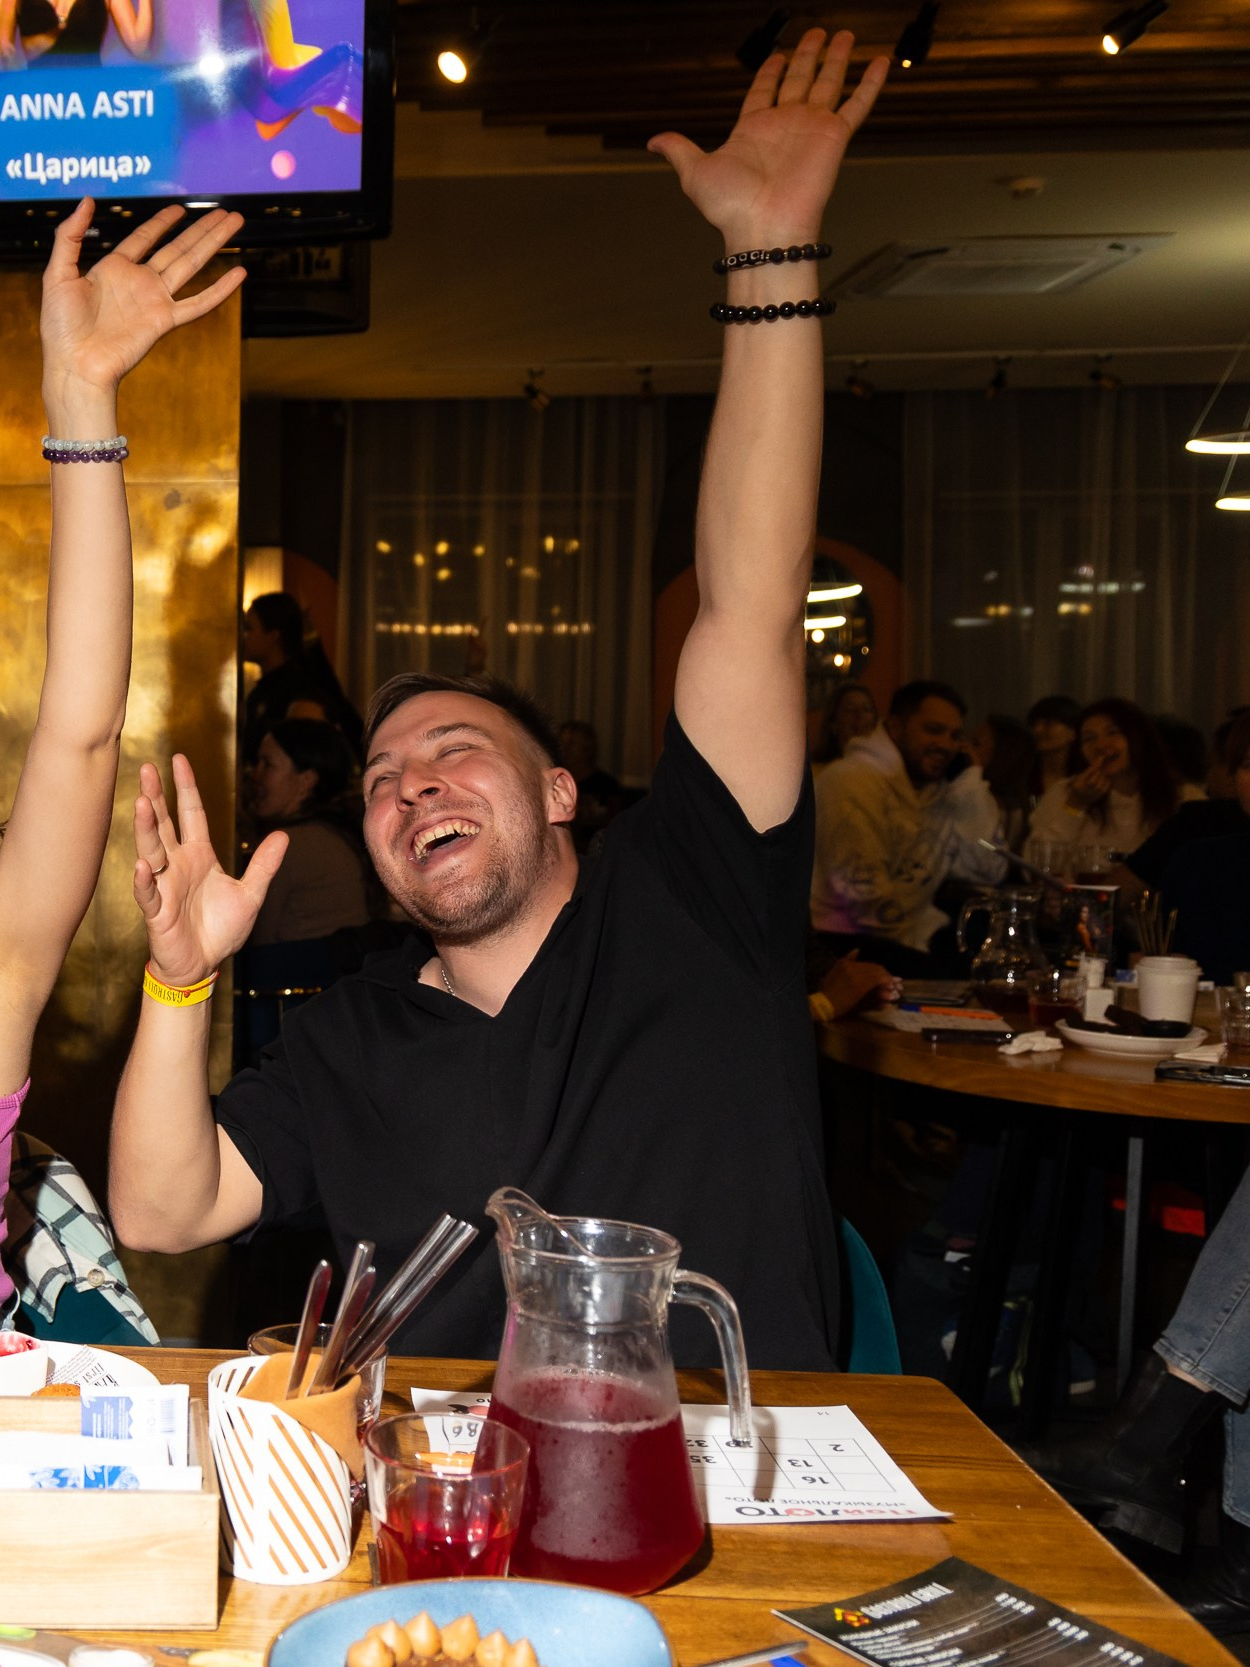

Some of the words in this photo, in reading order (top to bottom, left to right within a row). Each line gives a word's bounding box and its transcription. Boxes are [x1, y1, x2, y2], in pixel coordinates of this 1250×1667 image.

[0, 93, 85, 122] ANNA
[93, 90, 154, 119] ASTI
[6, 152, 151, 184] «Царица»
[829, 1443, 845, 1452] 2
[788, 1459, 813, 1468] 13
[802, 1476, 829, 1485] 16
